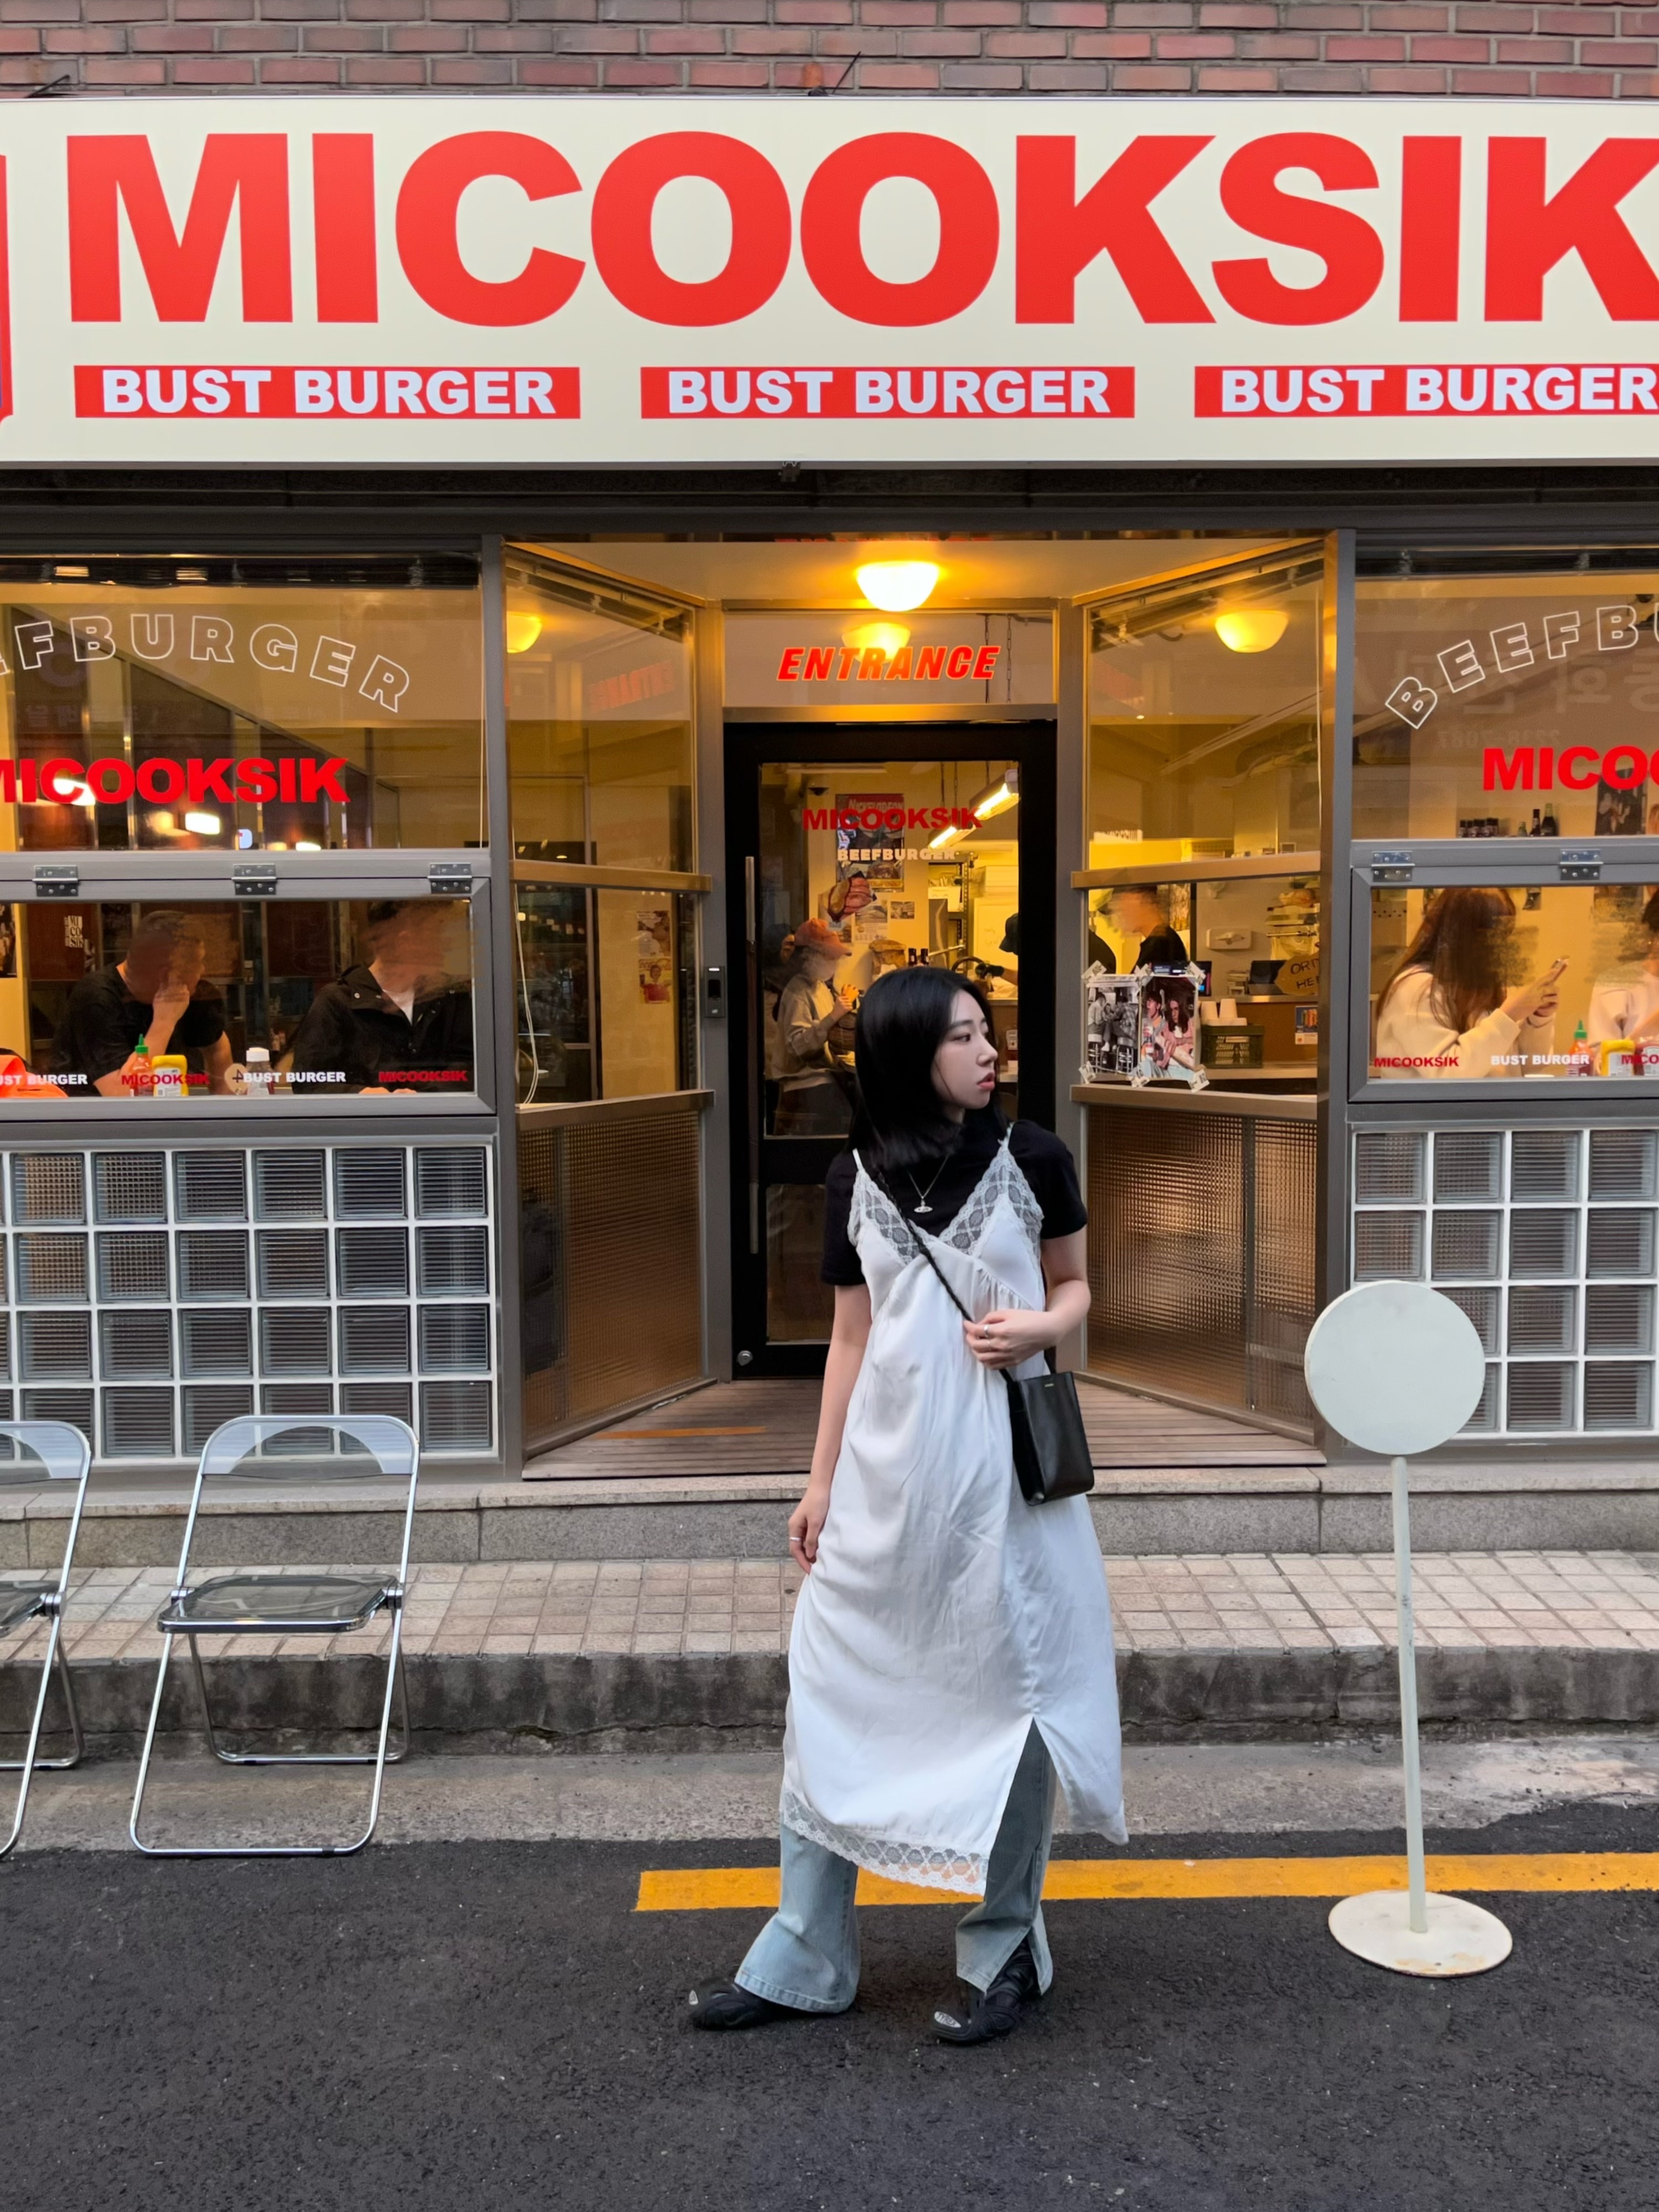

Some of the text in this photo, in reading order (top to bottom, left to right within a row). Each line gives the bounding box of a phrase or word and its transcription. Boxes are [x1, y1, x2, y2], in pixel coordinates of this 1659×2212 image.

[66, 130, 1659, 327] MICOOKSIK
[102, 369, 557, 415] BUST BURGER
[668, 370, 1111, 414] BUST BURGER
[1222, 367, 1659, 412] BUST BURGER
[0, 613, 410, 713] FBURGER
[776, 645, 1001, 681] ENTRANCE
[1385, 602, 1659, 730] BEEFB
[1482, 745, 1659, 791] MICO
[803, 807, 983, 830] MICOOKSIK
[837, 848, 956, 861] BEEFBURGER
[1374, 1056, 1460, 1067] MICOOKSIK
[1491, 1054, 1590, 1065] BUST BURGER
[27, 1074, 88, 1085] BURGER
[121, 1073, 210, 1085] MICOOKSIK
[242, 1071, 347, 1083] BUST BURGER
[379, 1070, 468, 1083] MICOOKSIK
